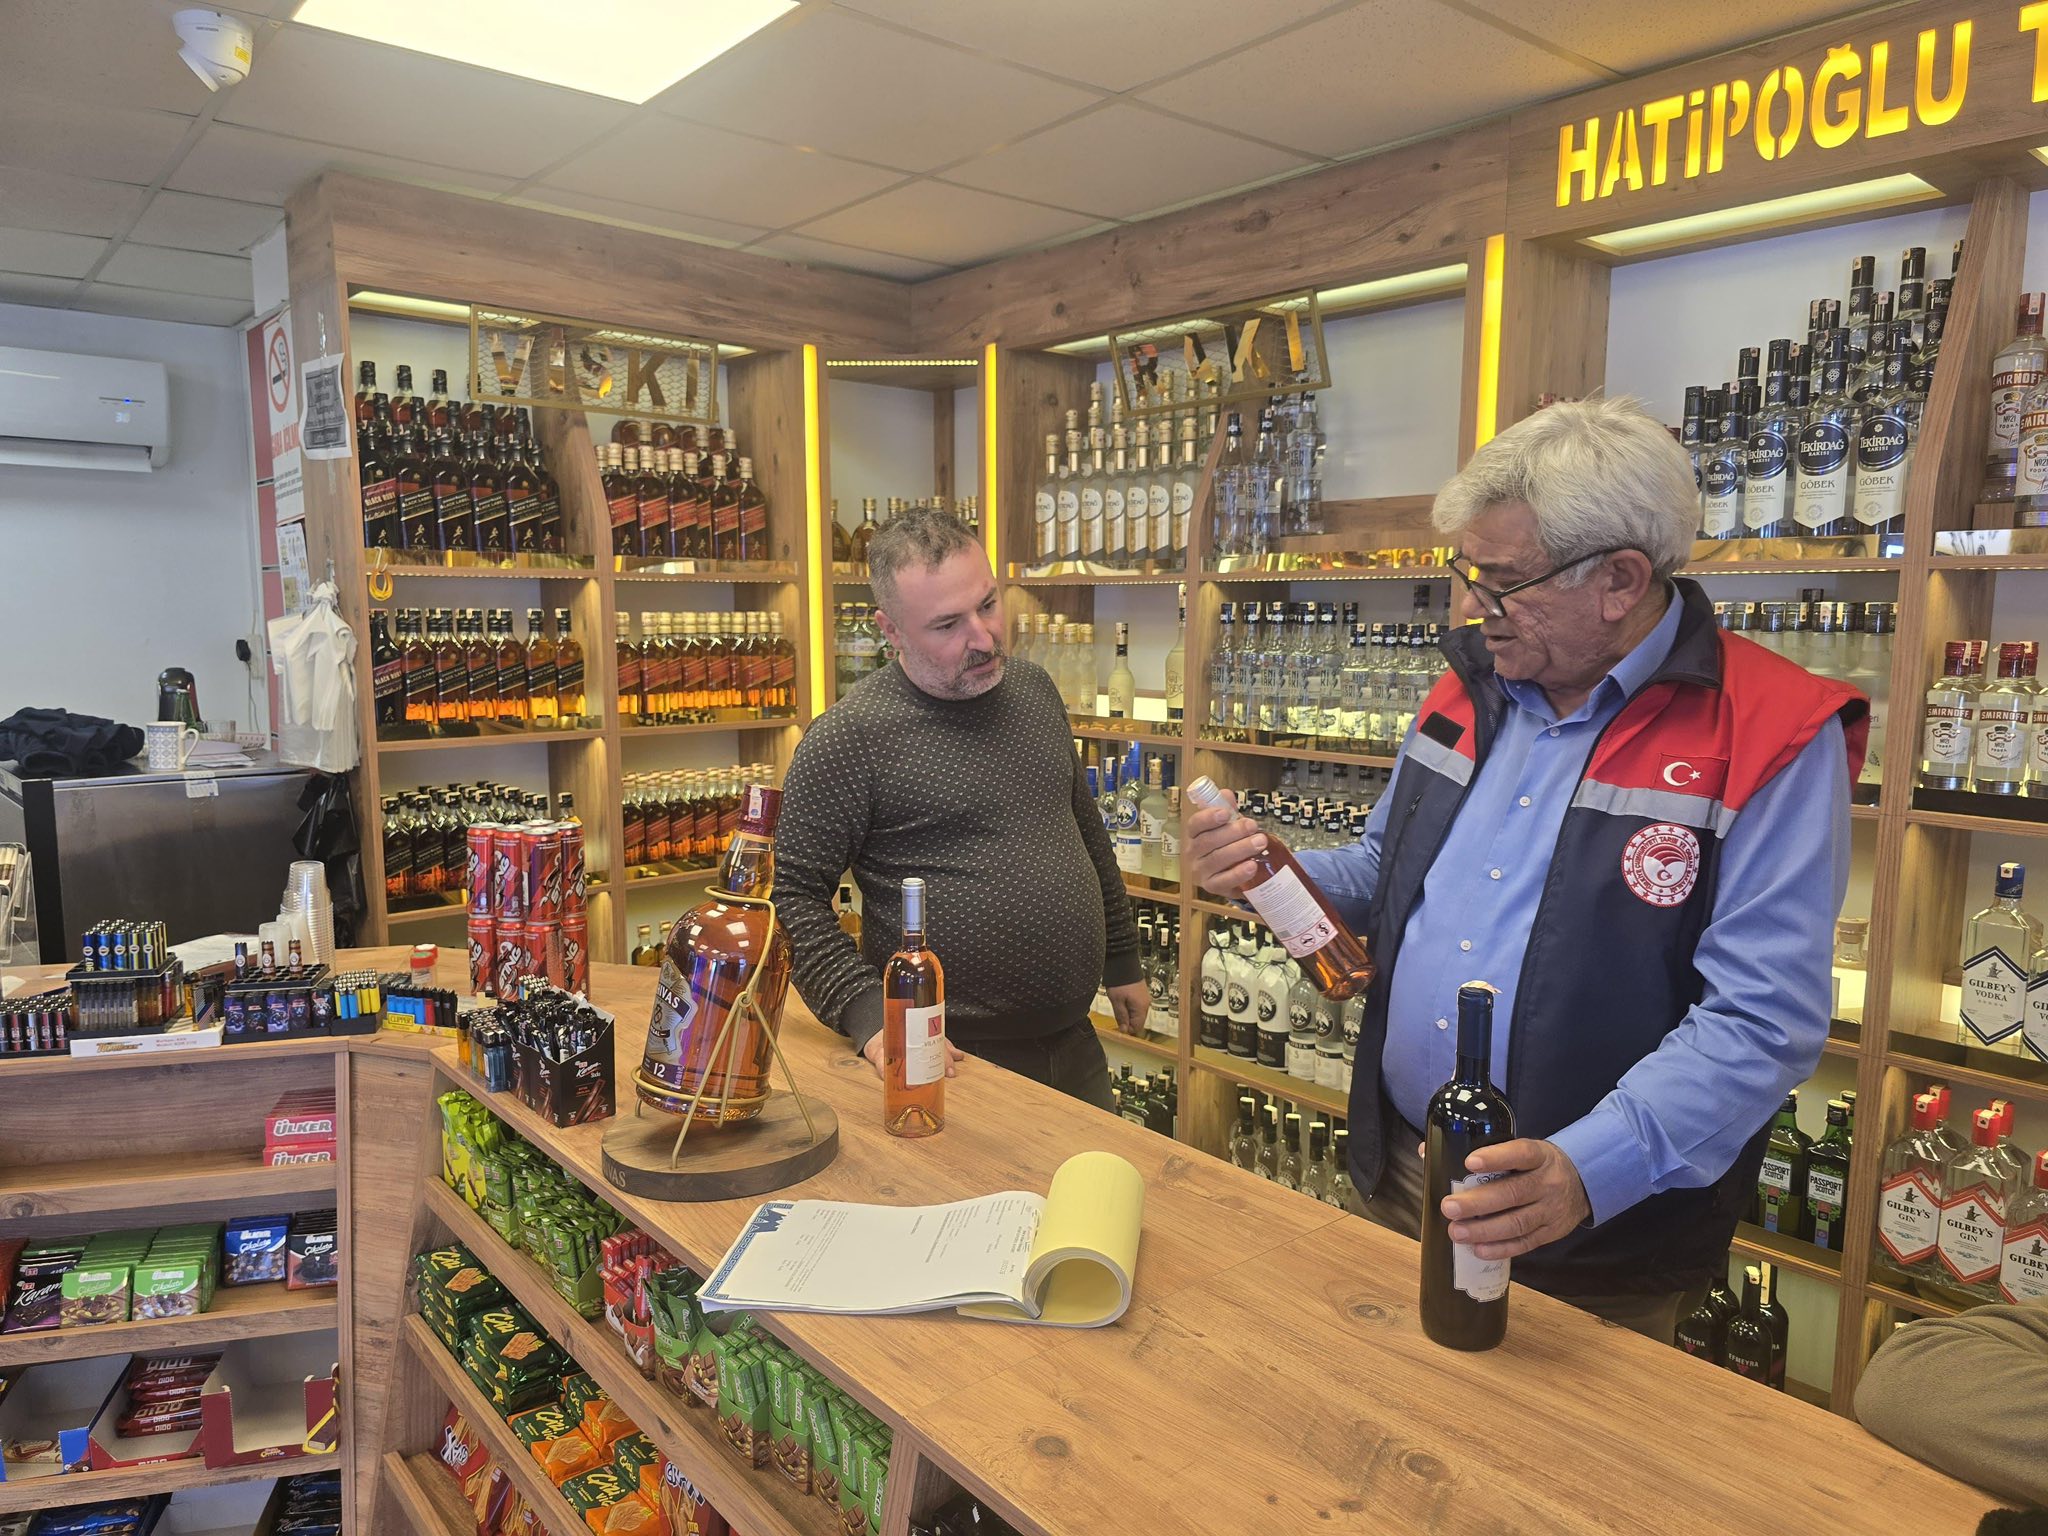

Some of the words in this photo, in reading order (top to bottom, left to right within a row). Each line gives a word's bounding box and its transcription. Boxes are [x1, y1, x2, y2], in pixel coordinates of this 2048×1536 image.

[1800, 438, 1845, 454] TEKİRDAĞ
[1859, 433, 1905, 449] TEKİRDAĞ
[1747, 446, 1784, 460] EKİRDAĞ
[1800, 479, 1836, 490] GÖBEK
[1859, 475, 1895, 486] GÖBEK
[1927, 707, 1970, 719] SMIRNOFF
[1981, 711, 2026, 721] SMIRNOFF
[1969, 978, 2017, 994] GILBEY'S
[1975, 989, 2008, 1002] VODKA
[653, 1062, 666, 1078] 12
[273, 1119, 332, 1136] ÜLKER
[1763, 1160, 1790, 1176] ASSPORT
[1764, 1169, 1784, 1181] SCOTCH
[1809, 1175, 1842, 1193] PASSPORT
[1815, 1184, 1836, 1197] SCOTCH
[1886, 1199, 1931, 1219] GILBEY'S
[1898, 1213, 1916, 1223] GIN
[1946, 1218, 1994, 1239] GILBEY'S
[1959, 1232, 1978, 1243] GIN
[2023, 1268, 2044, 1279] GIN
